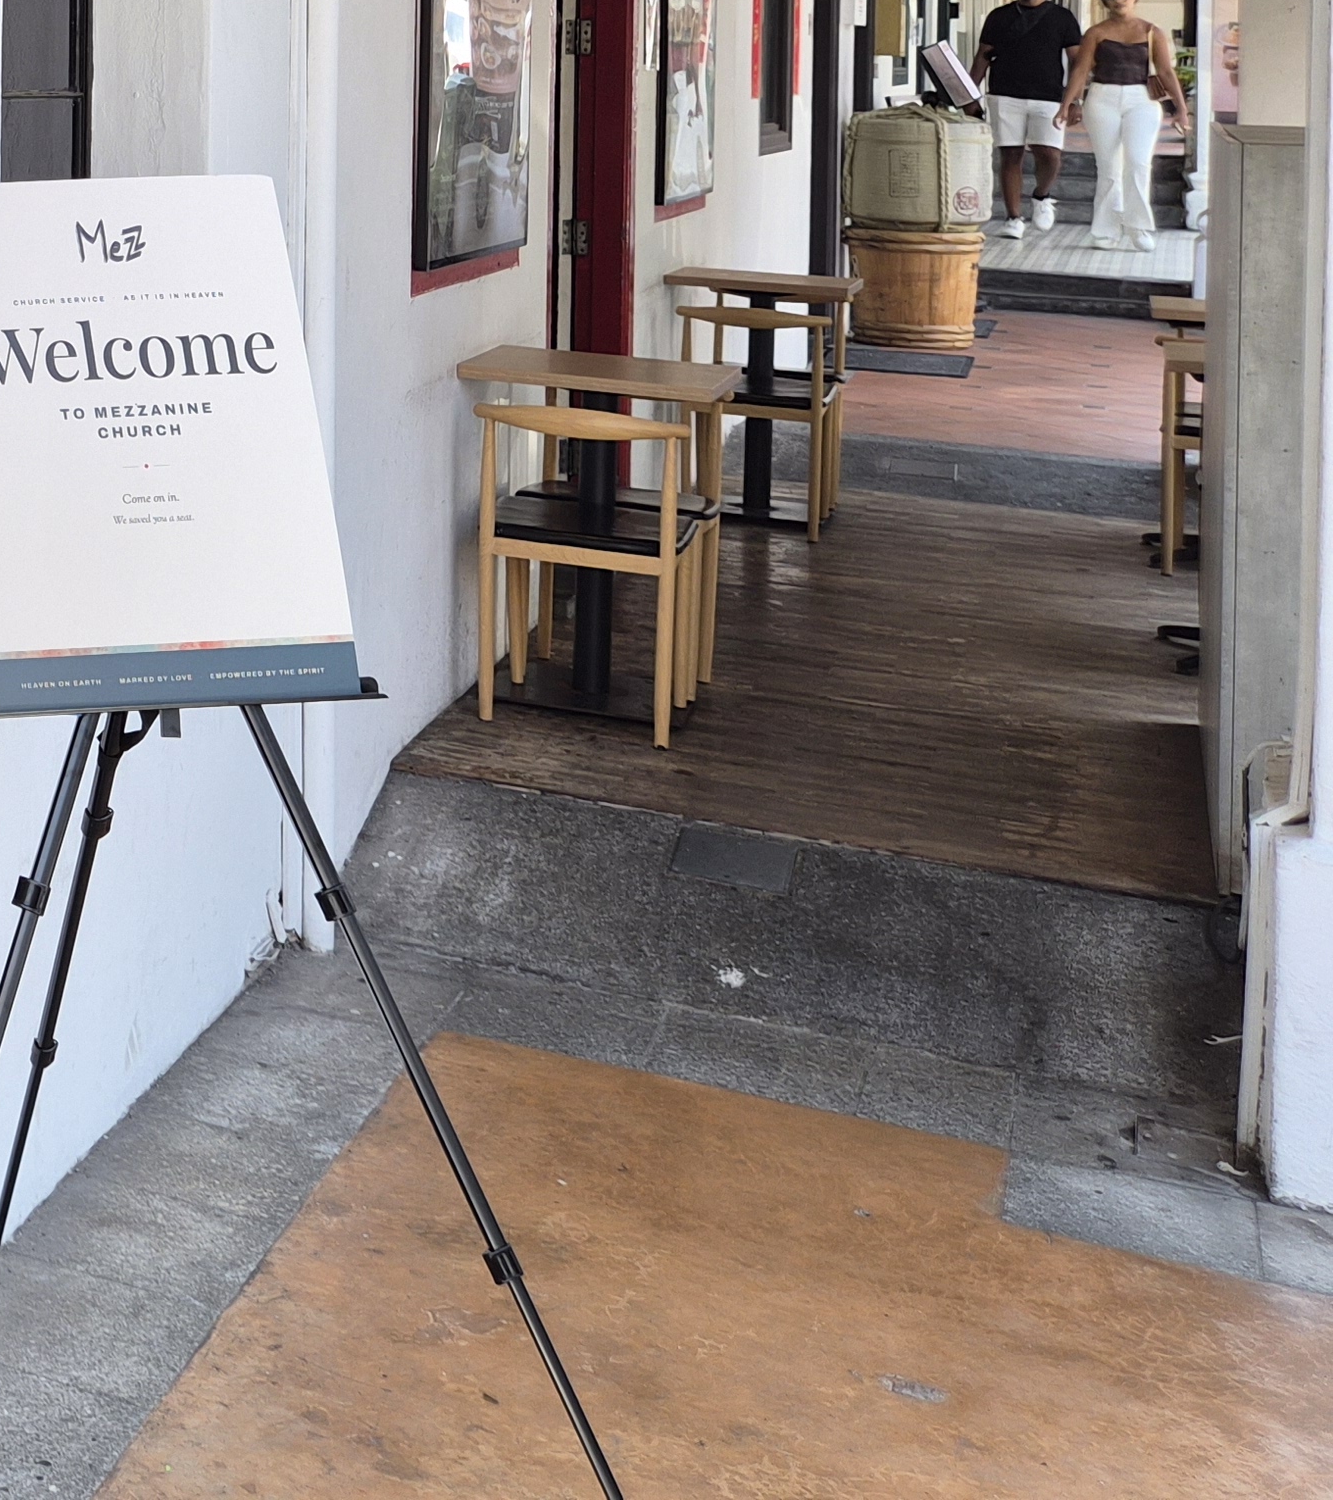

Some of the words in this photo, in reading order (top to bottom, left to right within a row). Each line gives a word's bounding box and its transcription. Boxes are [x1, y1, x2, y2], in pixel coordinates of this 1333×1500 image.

[13, 298, 55, 307] CHURCH
[60, 295, 105, 304] SERVICE
[123, 293, 136, 301] AS
[140, 293, 150, 301] IT
[184, 291, 224, 299] HEAVEN
[59, 408, 85, 420] TO
[94, 402, 213, 419] MEZZANINE
[98, 424, 182, 439] CHURCH
[122, 493, 151, 504] Come
[168, 492, 180, 502] in.
[113, 515, 127, 524] We
[129, 513, 151, 524] saved
[153, 516, 167, 525] you
[73, 679, 102, 687] EARTH
[119, 676, 154, 684] MARKED
[210, 670, 263, 679] EMPOWERED
[279, 668, 295, 676] THE
[298, 667, 325, 675] SPIRIT
